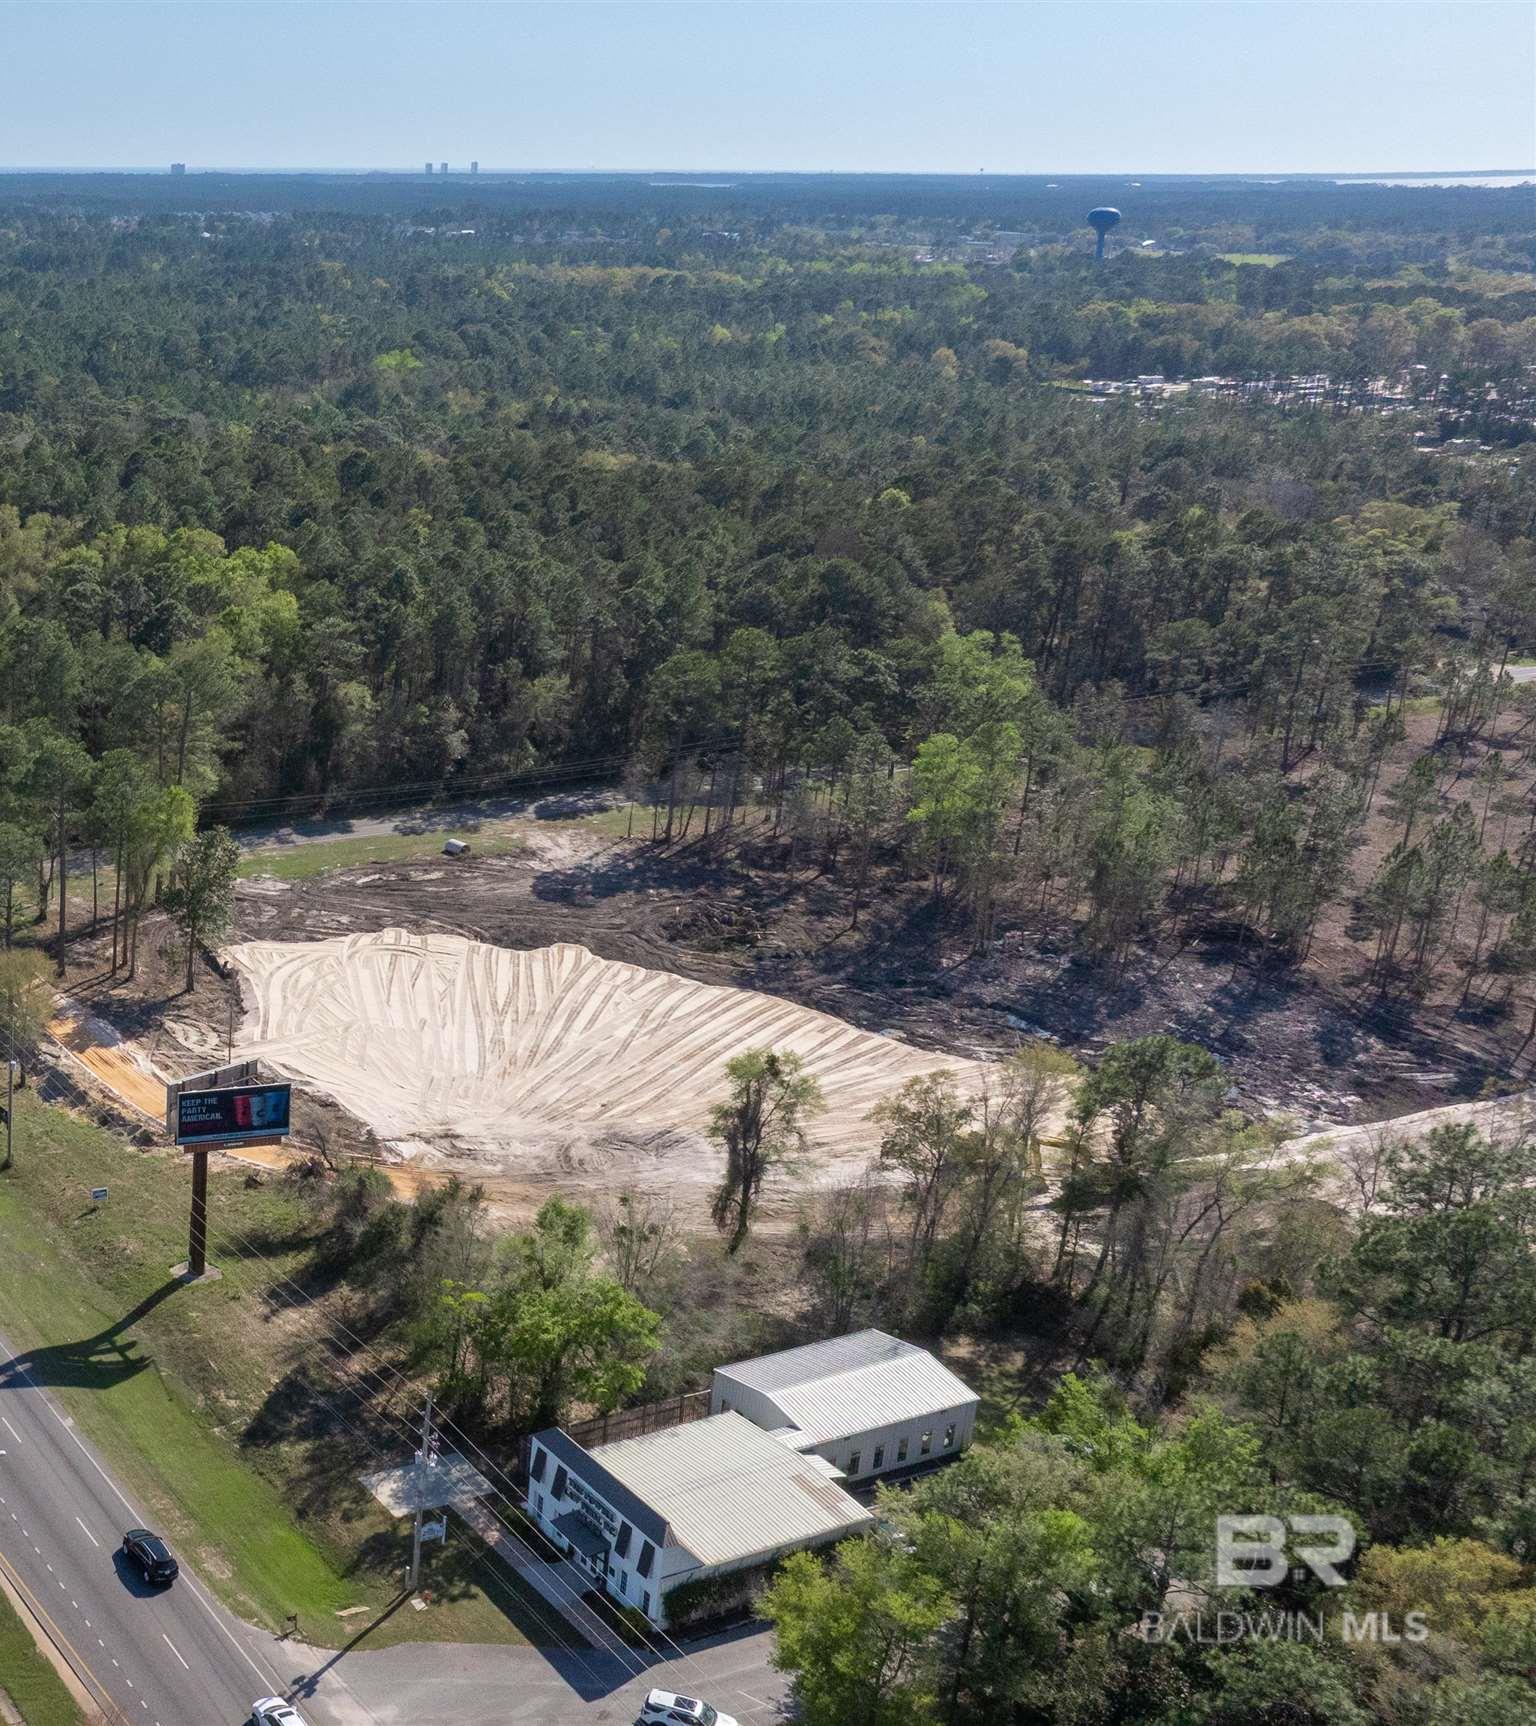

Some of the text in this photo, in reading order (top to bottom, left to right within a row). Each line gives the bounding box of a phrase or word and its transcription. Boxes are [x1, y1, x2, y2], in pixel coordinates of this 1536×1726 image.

[182, 1097, 218, 1107] KEEP THE
[182, 1106, 207, 1114] PARTY
